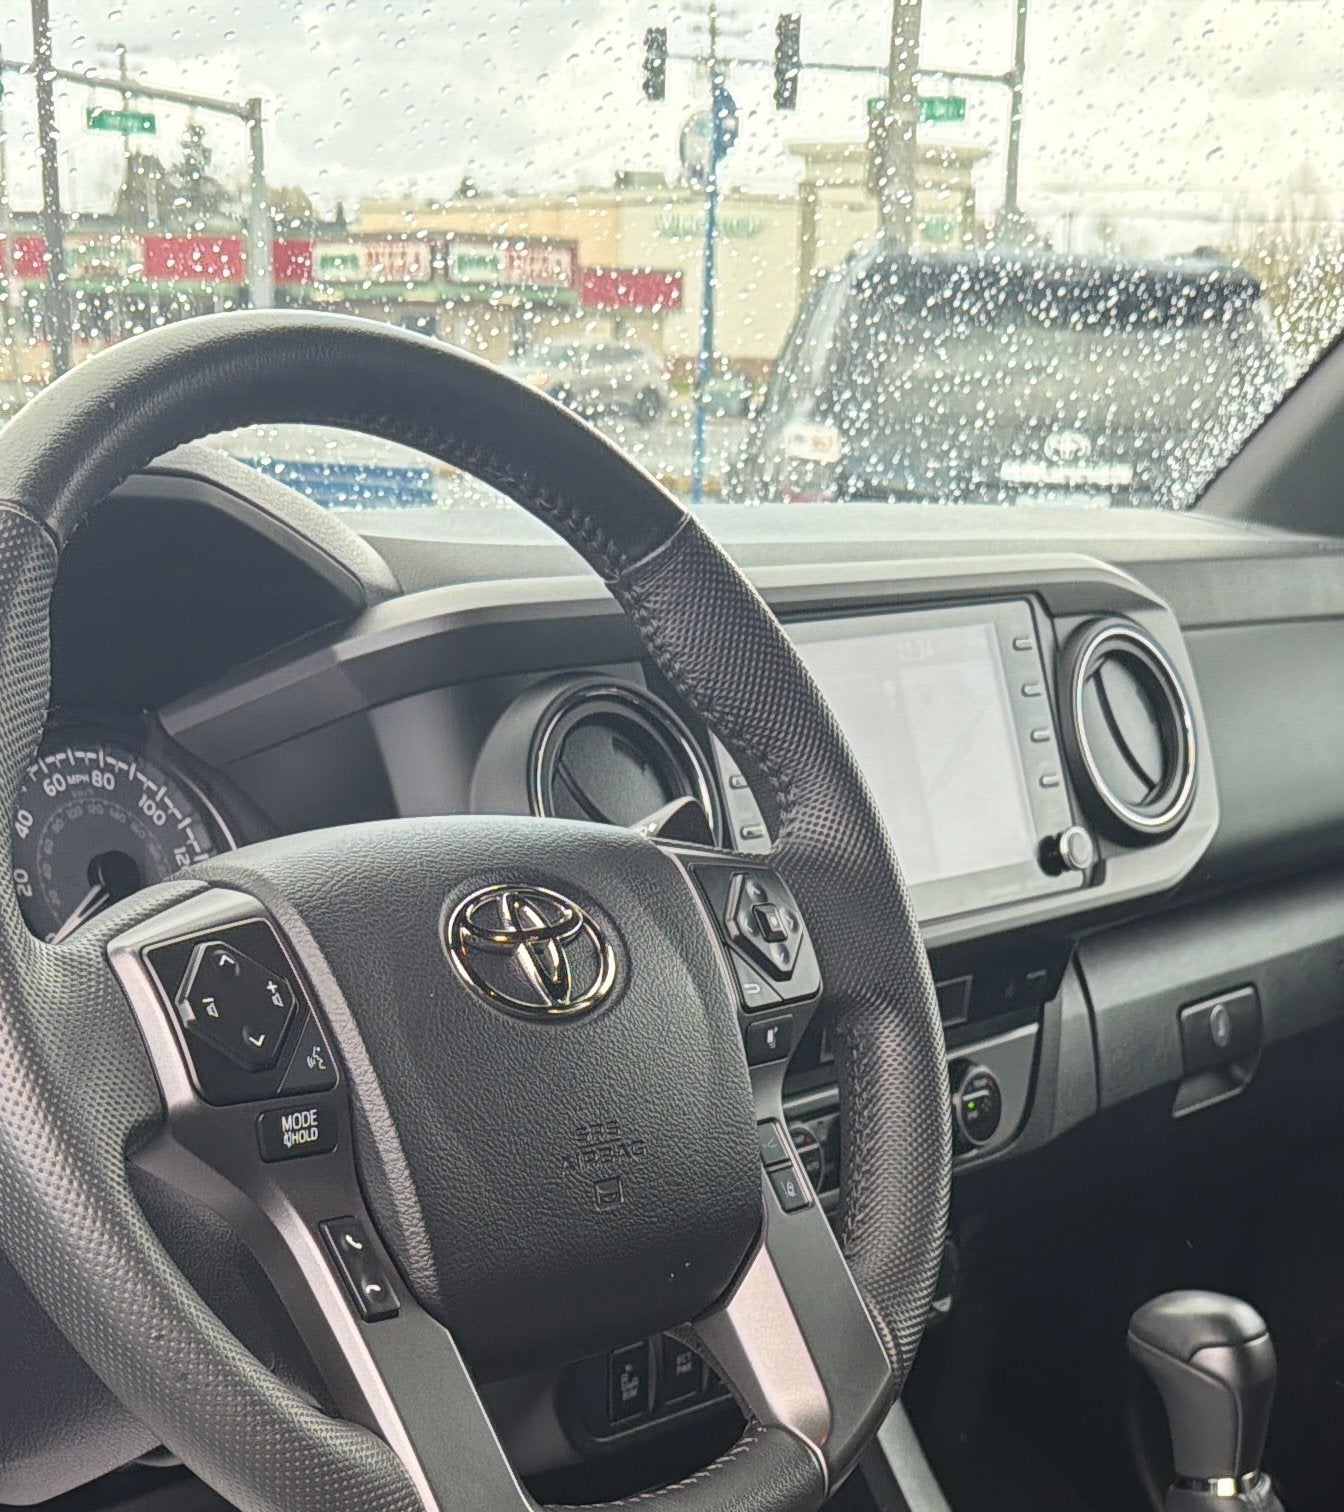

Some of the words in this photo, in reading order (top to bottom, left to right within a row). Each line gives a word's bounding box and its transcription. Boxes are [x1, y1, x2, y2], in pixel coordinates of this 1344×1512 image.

[43, 773, 67, 797] 60
[66, 774, 89, 785] MPH
[91, 769, 115, 791] 80
[138, 793, 167, 826] 100
[15, 809, 34, 839] 40
[173, 846, 192, 868] 12
[13, 868, 33, 897] 20
[281, 1108, 318, 1132] MODE
[292, 1127, 318, 1145] HOLD
